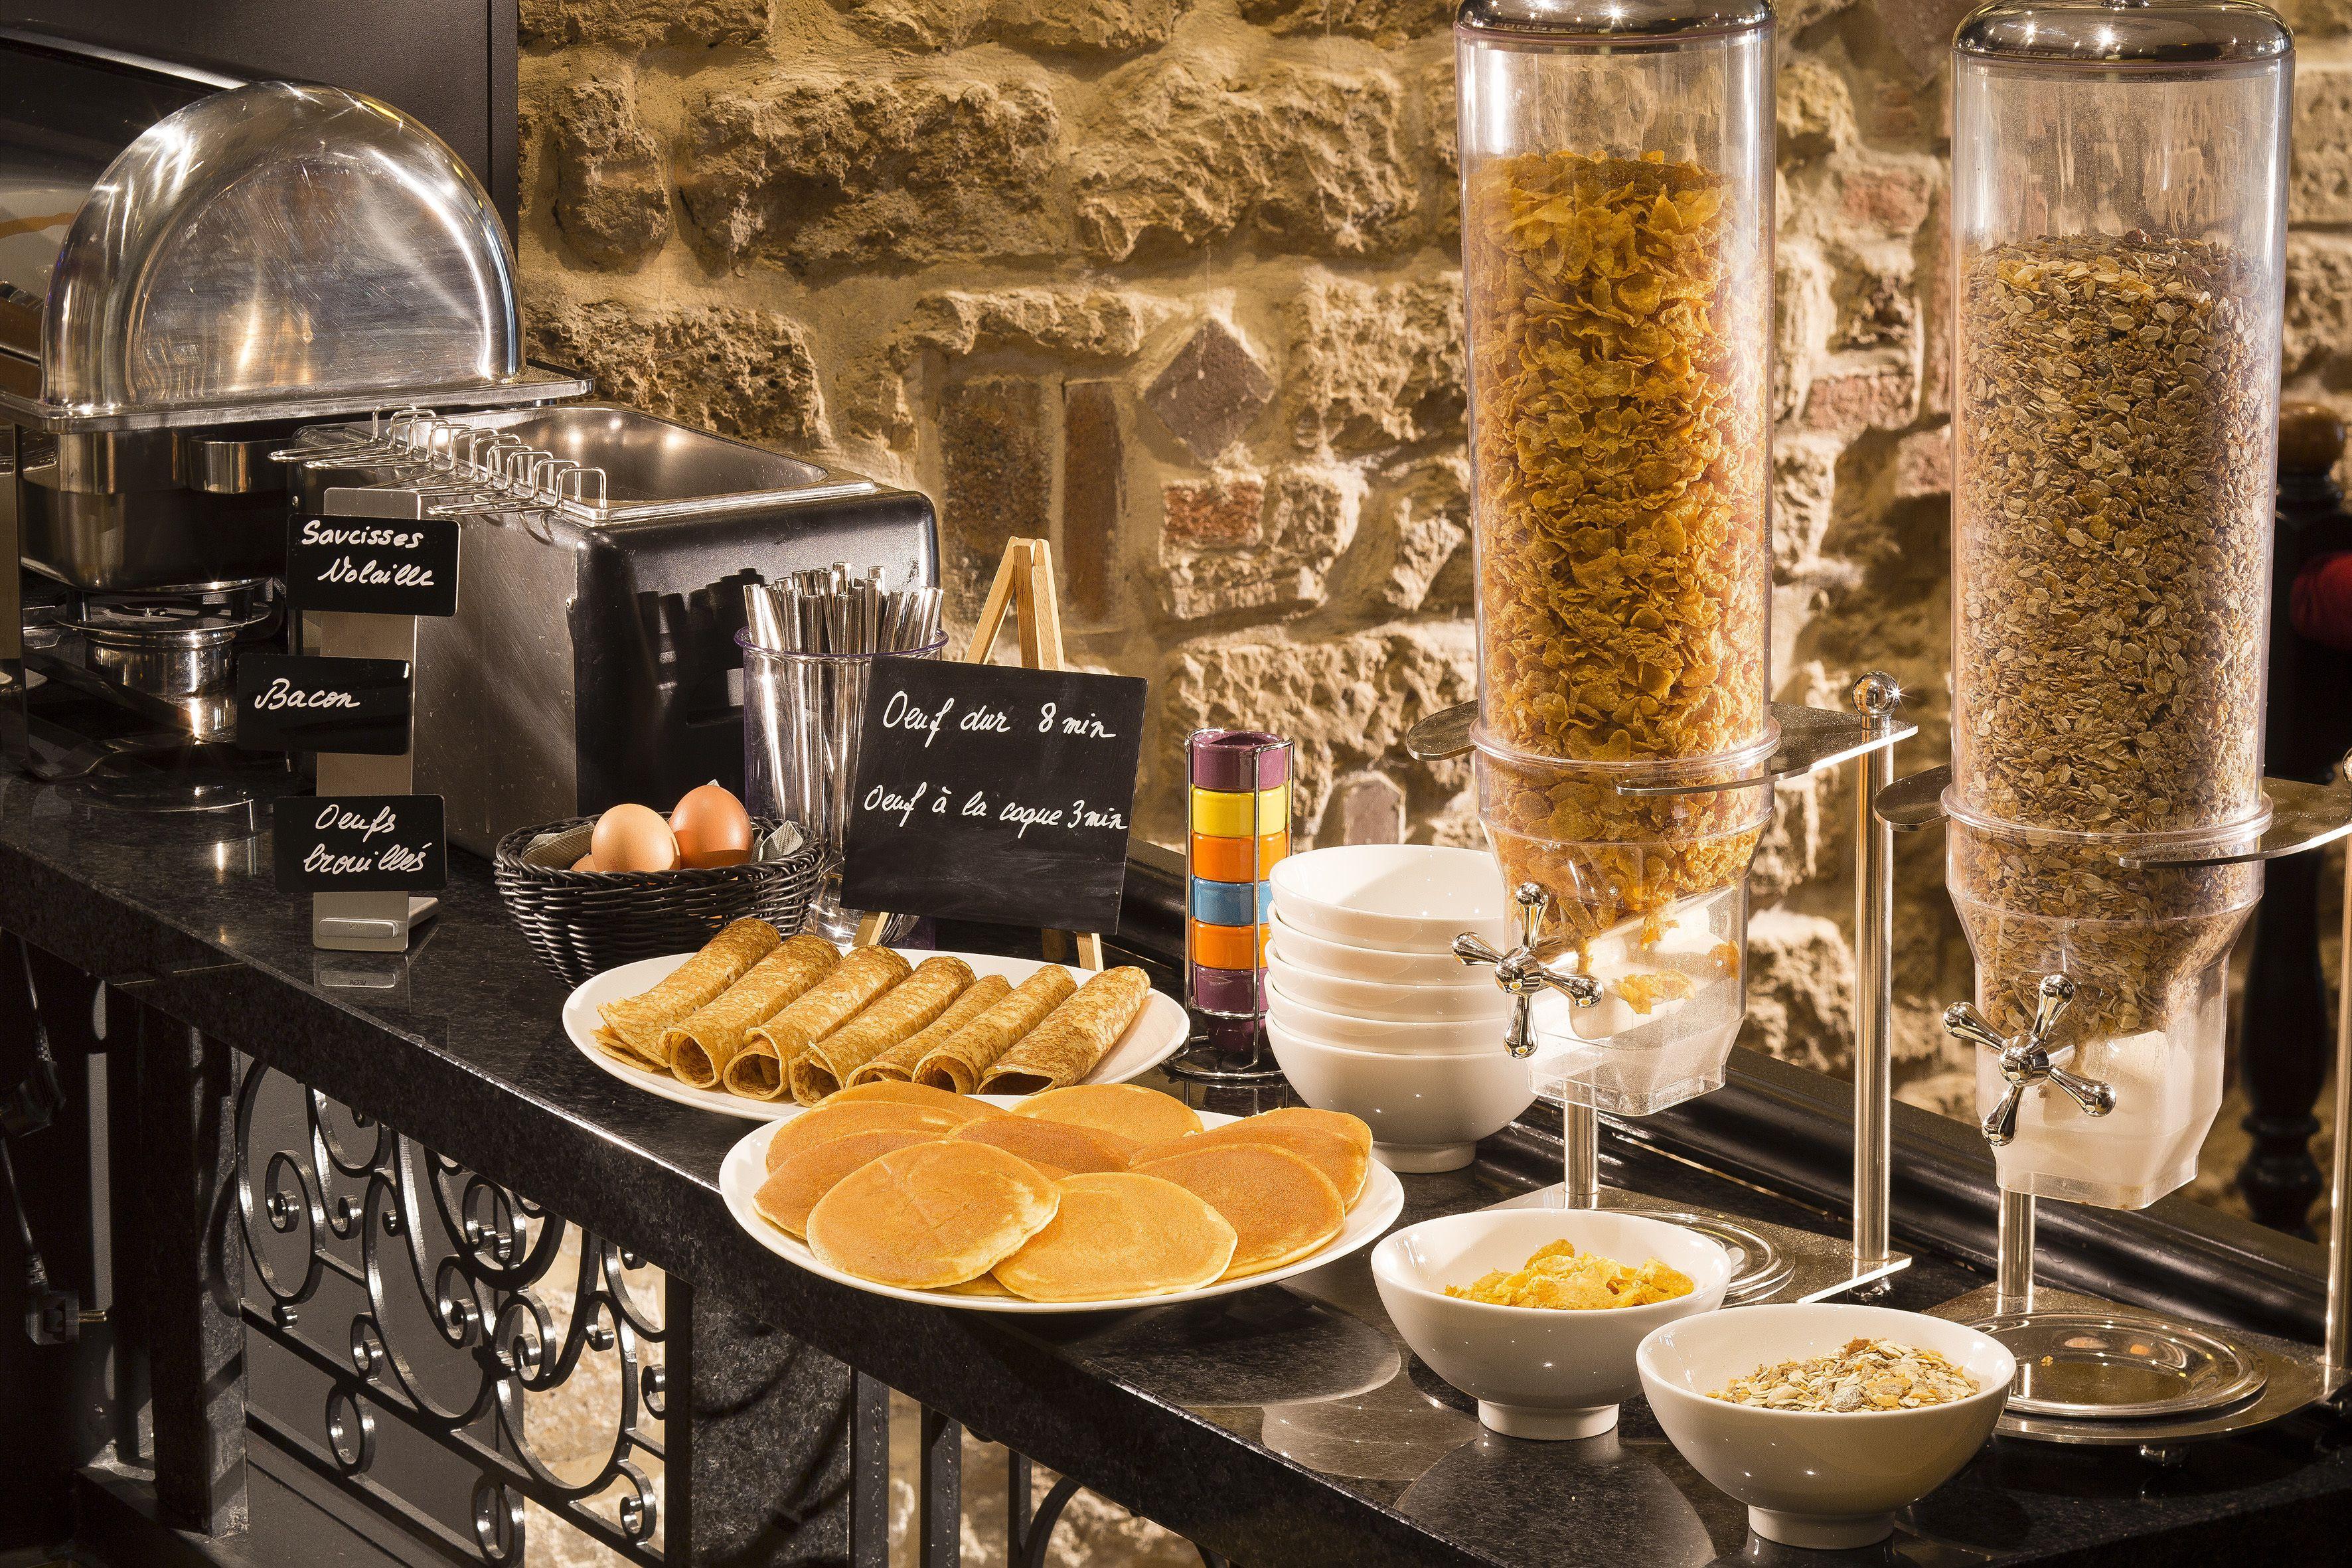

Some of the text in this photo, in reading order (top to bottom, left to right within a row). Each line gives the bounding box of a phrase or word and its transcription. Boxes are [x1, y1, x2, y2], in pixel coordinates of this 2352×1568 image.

[317, 556, 434, 586] Volaille
[254, 678, 360, 710] Bacon
[883, 691, 955, 747] Oeuf
[961, 705, 1010, 732] dur
[1062, 713, 1116, 738] min
[315, 805, 396, 842] Oeufs
[864, 782, 927, 827] Oeuf
[932, 787, 951, 813] à
[961, 791, 986, 816] la
[1000, 803, 1062, 838] coque
[304, 842, 432, 874] brouillés
